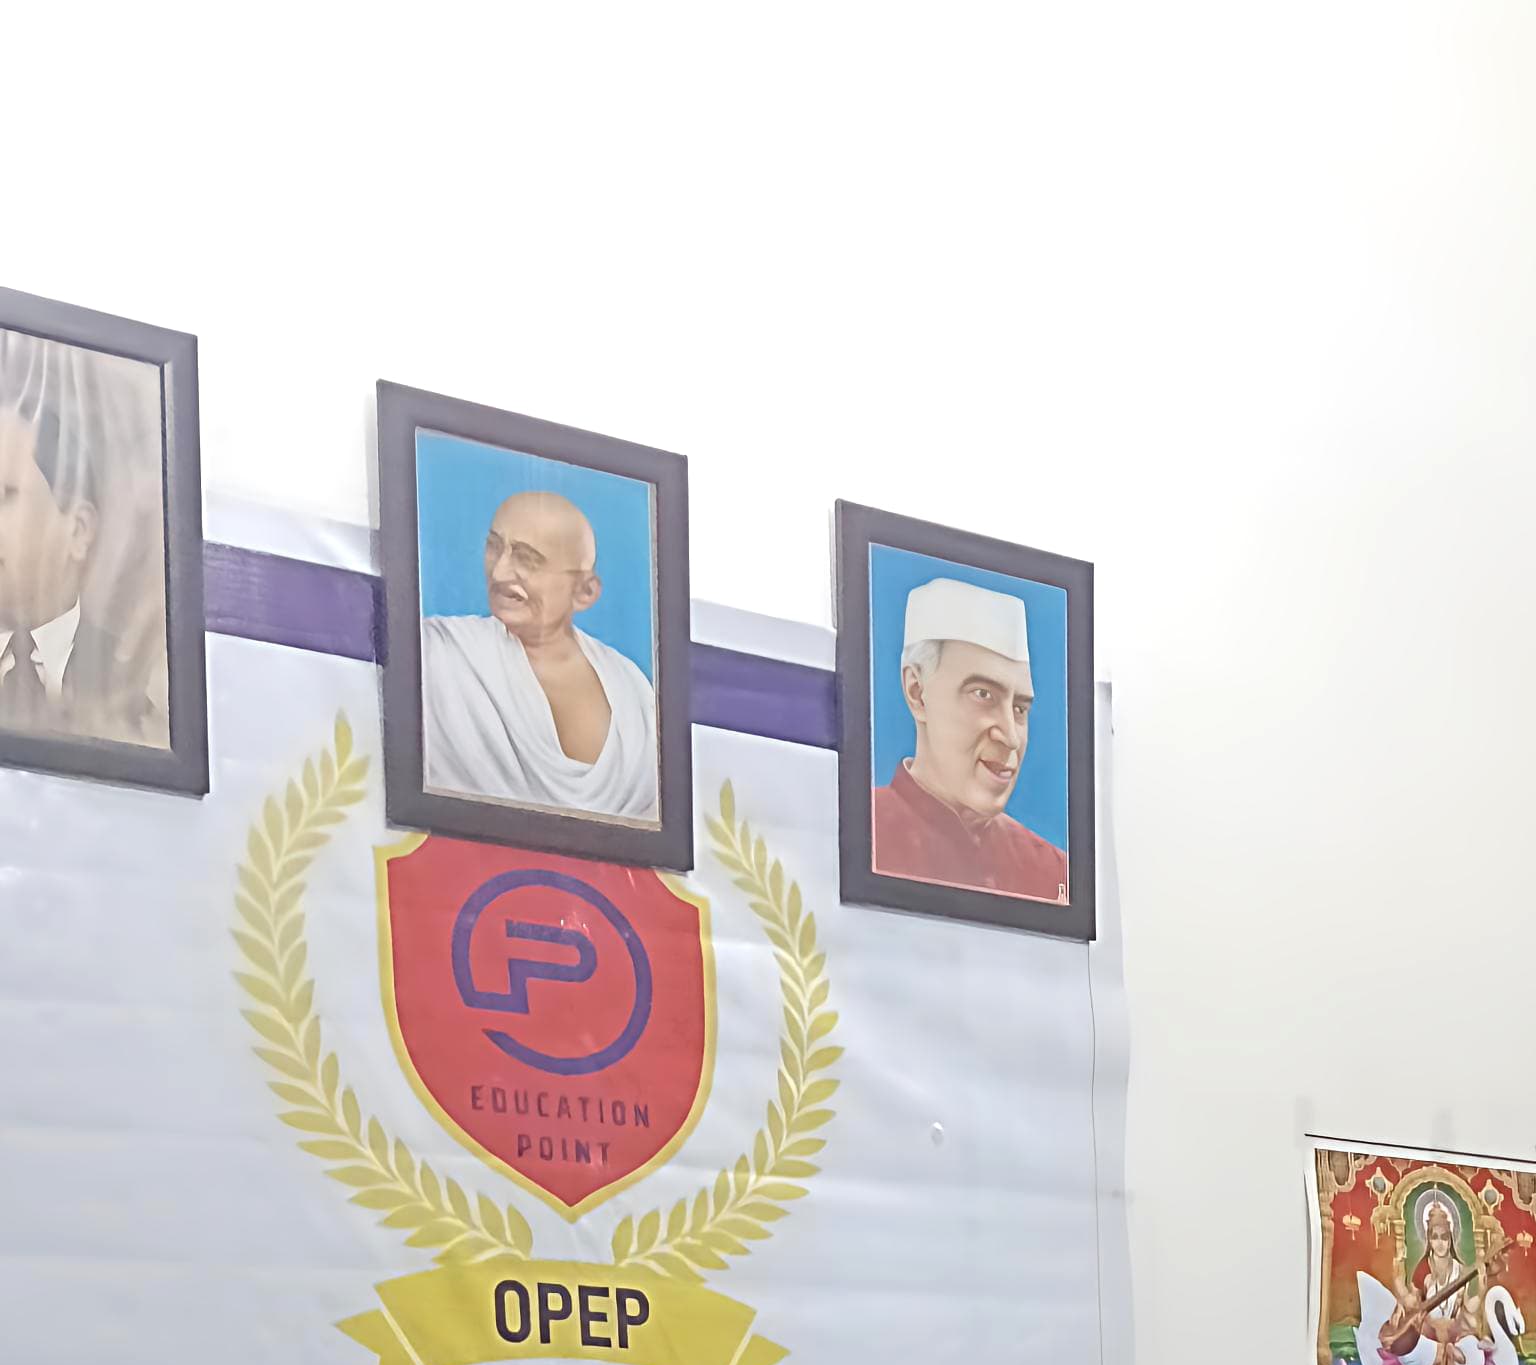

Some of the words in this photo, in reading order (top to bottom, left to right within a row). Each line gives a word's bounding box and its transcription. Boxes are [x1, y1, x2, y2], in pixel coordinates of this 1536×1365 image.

[471, 1085, 650, 1129] EDUCATION
[517, 1133, 612, 1166] POINT
[494, 1279, 651, 1349] OPEP
